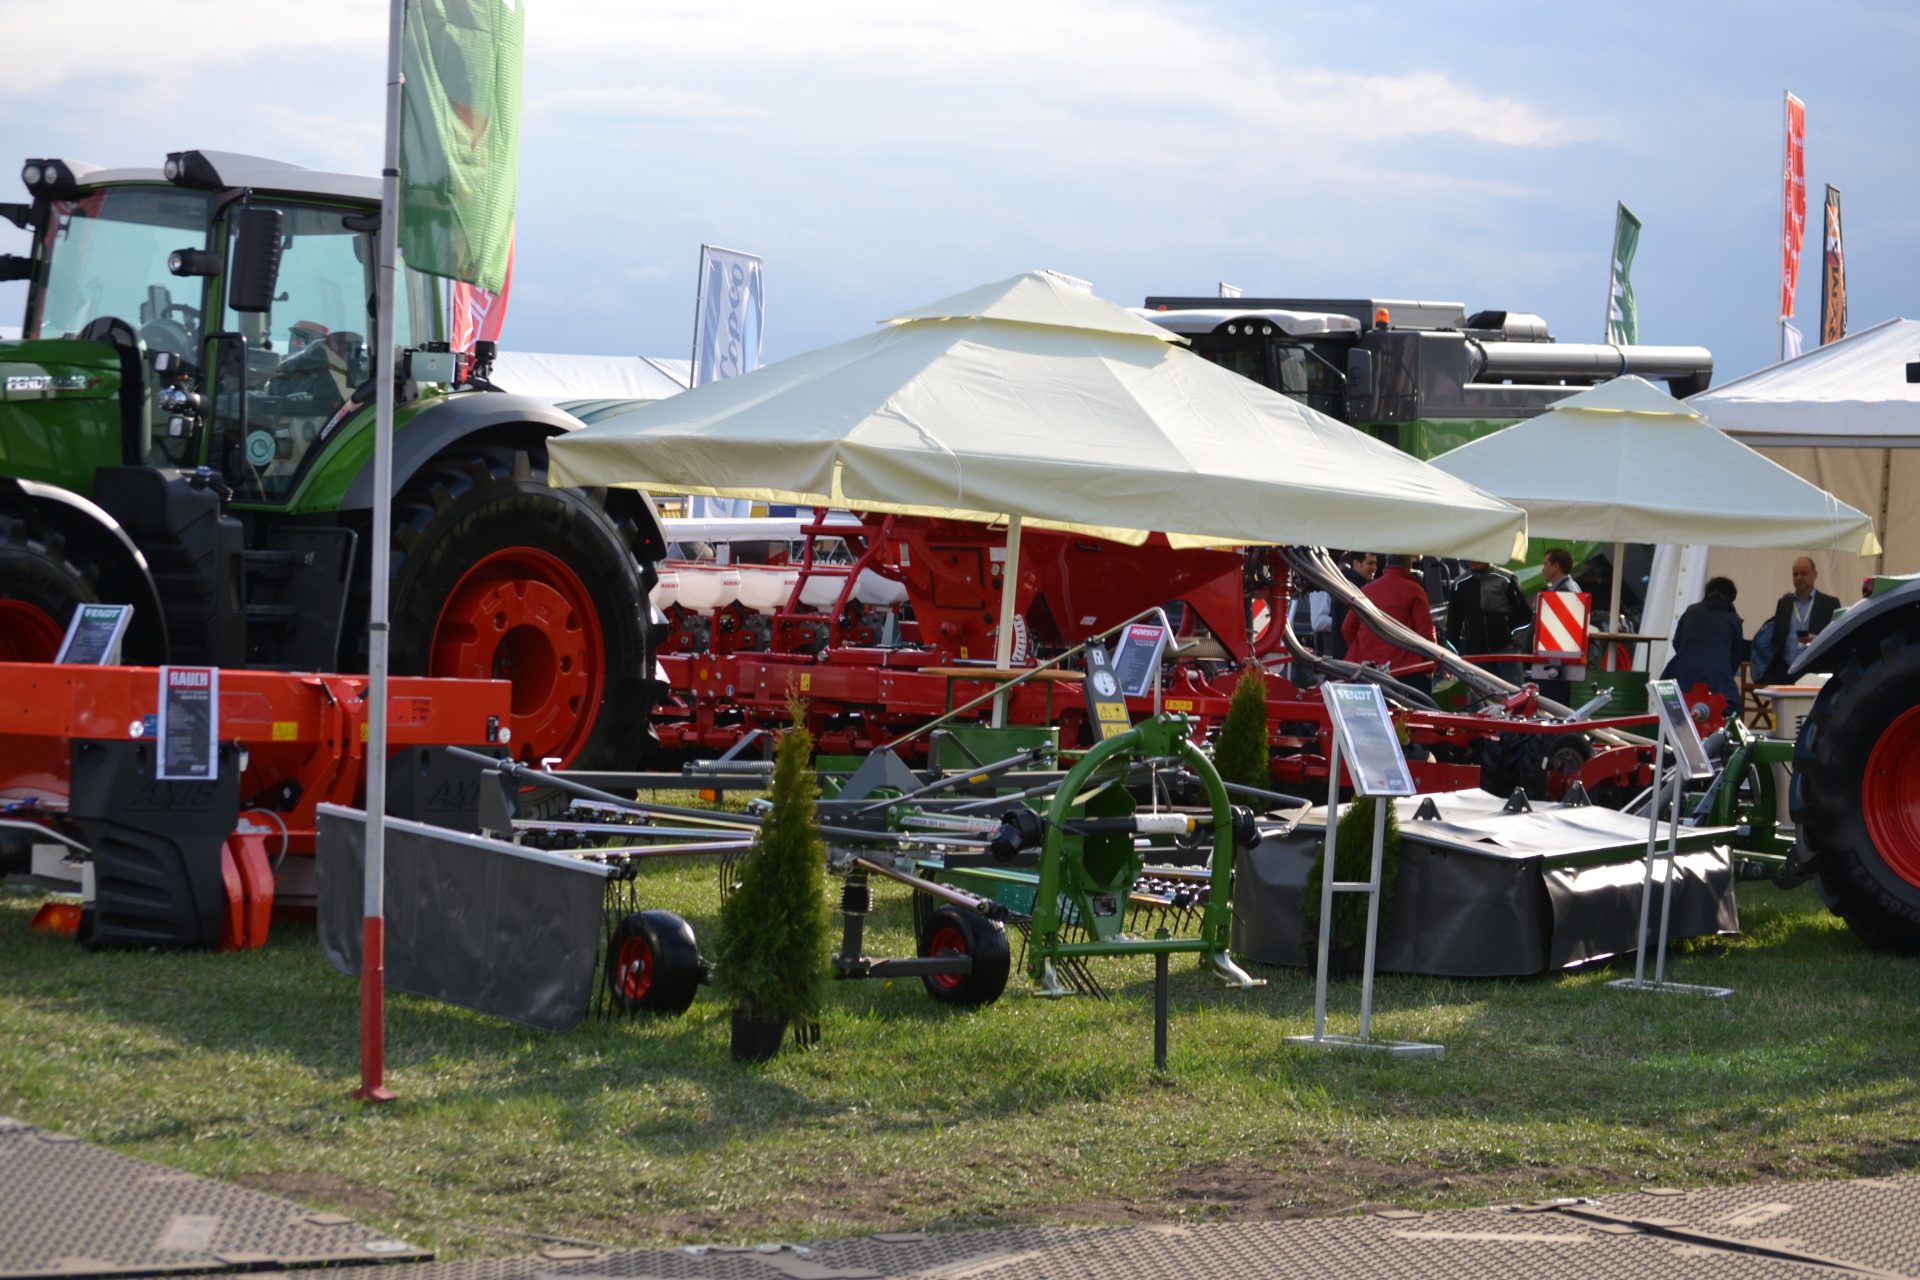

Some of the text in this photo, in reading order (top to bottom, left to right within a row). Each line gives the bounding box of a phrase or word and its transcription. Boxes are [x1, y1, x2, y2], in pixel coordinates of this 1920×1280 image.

[720, 263, 745, 379] Copco
[7, 376, 52, 391] FENDT
[84, 608, 120, 618] FENDT
[1132, 628, 1160, 637] HORSCH
[170, 671, 208, 687] RAUCH
[1337, 689, 1372, 701] FENDT
[130, 780, 218, 807] AXIS
